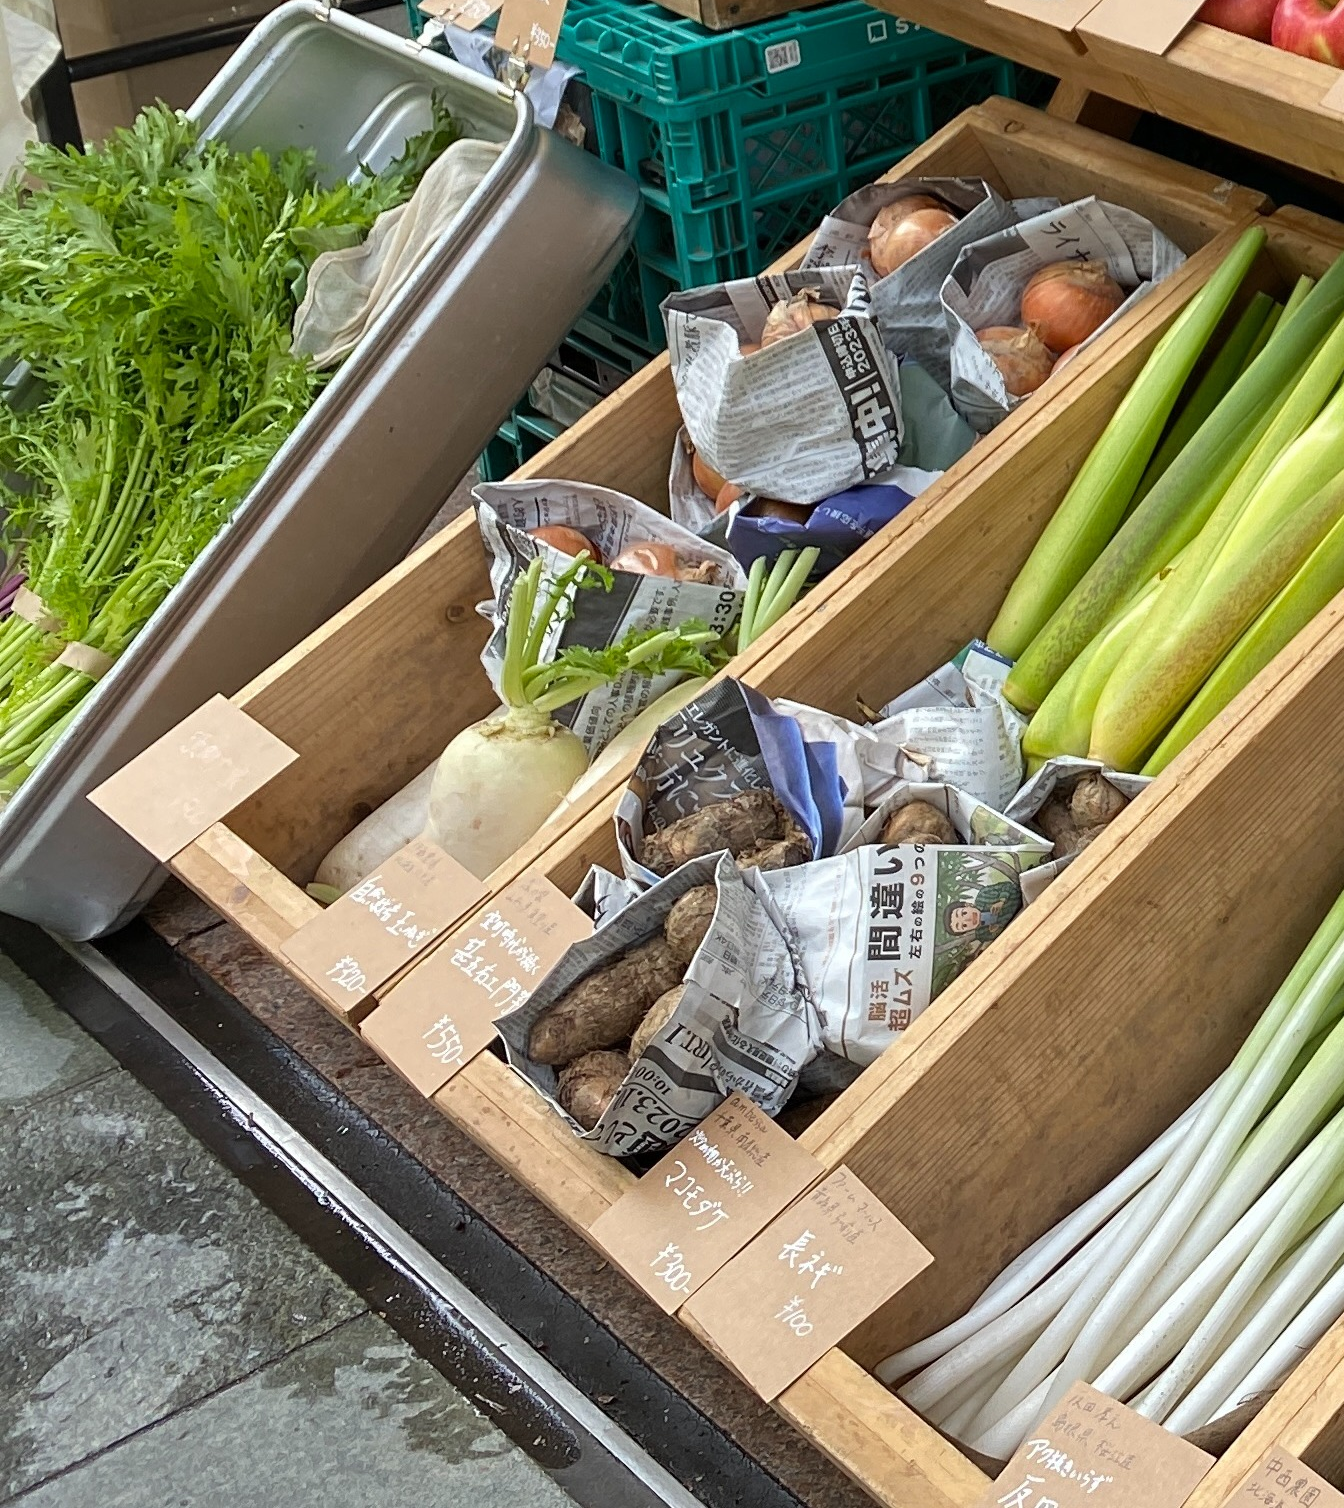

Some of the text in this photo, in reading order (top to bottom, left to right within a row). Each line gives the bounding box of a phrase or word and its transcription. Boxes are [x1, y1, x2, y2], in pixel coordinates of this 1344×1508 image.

[867, 979, 890, 1022] 脳活
[663, 1160, 730, 1232] マコモダケ
[777, 1229, 845, 1290] 長ネギ
[773, 1294, 814, 1338] ¥100
[1026, 1437, 1115, 1495] アク抜きいらず
[1265, 1456, 1323, 1508] 中西農園
